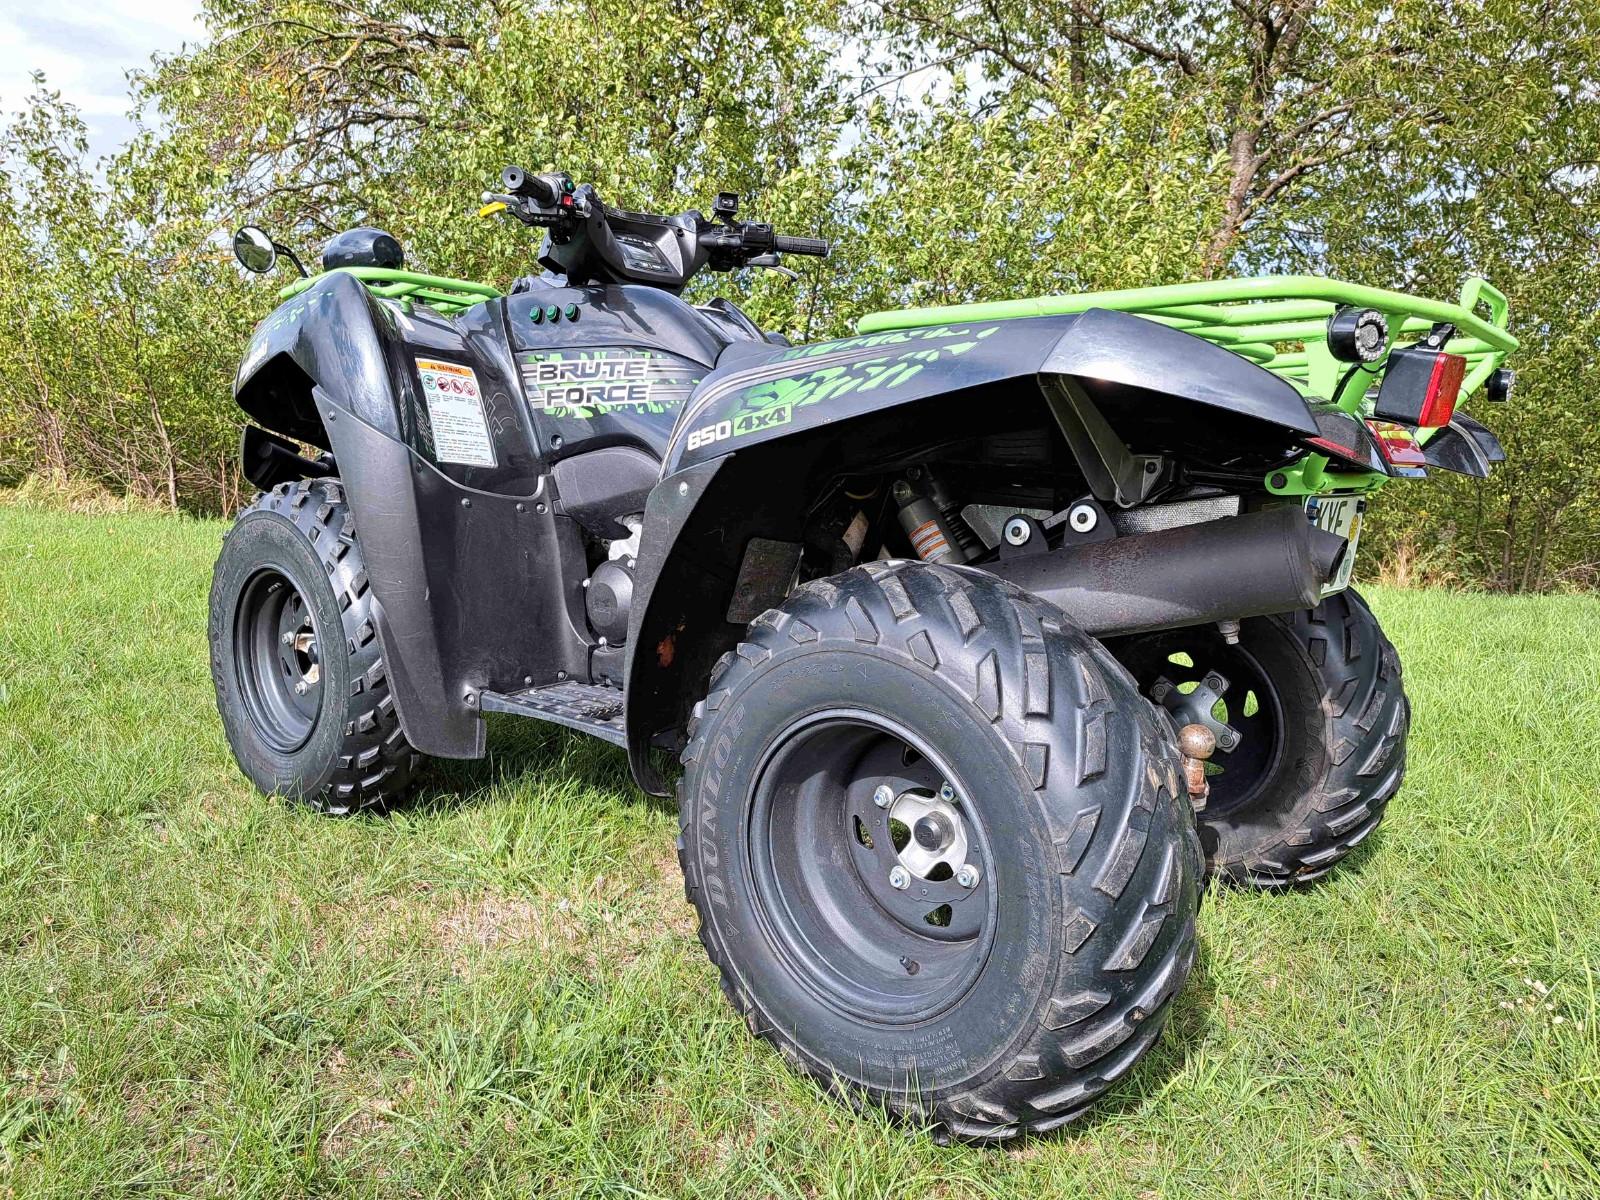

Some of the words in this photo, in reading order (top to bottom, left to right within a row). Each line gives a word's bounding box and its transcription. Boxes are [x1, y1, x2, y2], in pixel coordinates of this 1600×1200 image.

[537, 359, 648, 384] BRUTE
[545, 383, 650, 408] FORCE
[687, 420, 732, 451] 650
[736, 406, 786, 431] 4x4
[701, 702, 745, 907] DUNLOP
